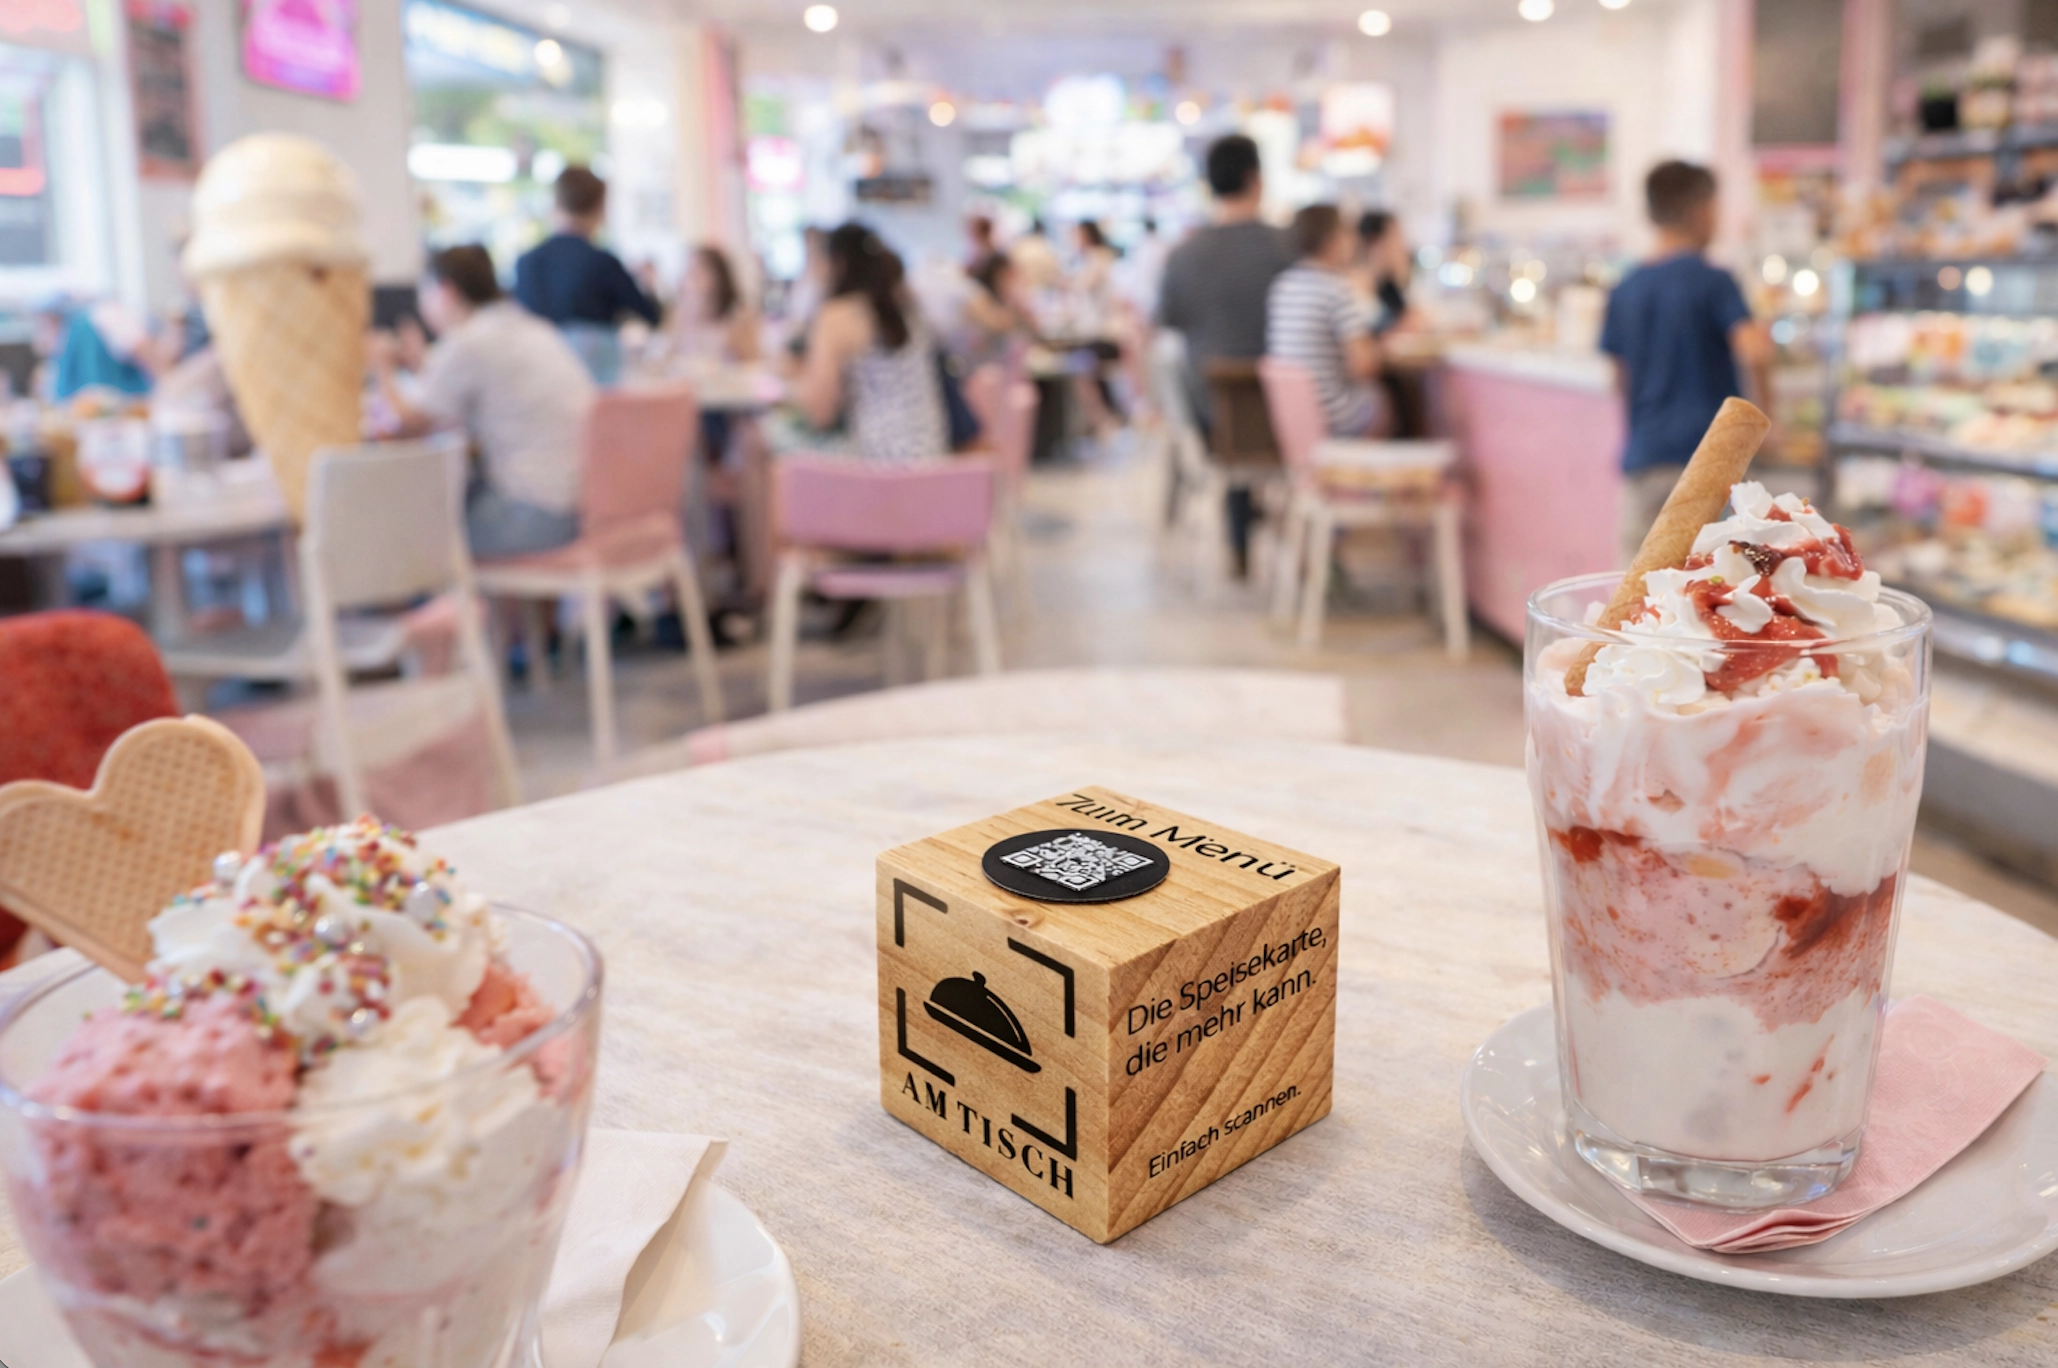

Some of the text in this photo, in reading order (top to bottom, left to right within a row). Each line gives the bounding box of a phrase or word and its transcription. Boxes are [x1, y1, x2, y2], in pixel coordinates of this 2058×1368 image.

[1056, 793, 1295, 881] Zum Menü
[1126, 969, 1316, 1076] die mehr kann.
[1127, 926, 1327, 1035] Die Speisekarte,
[902, 1071, 1074, 1198] AM TISCH
[1149, 1085, 1301, 1178] Einfach scannen.
